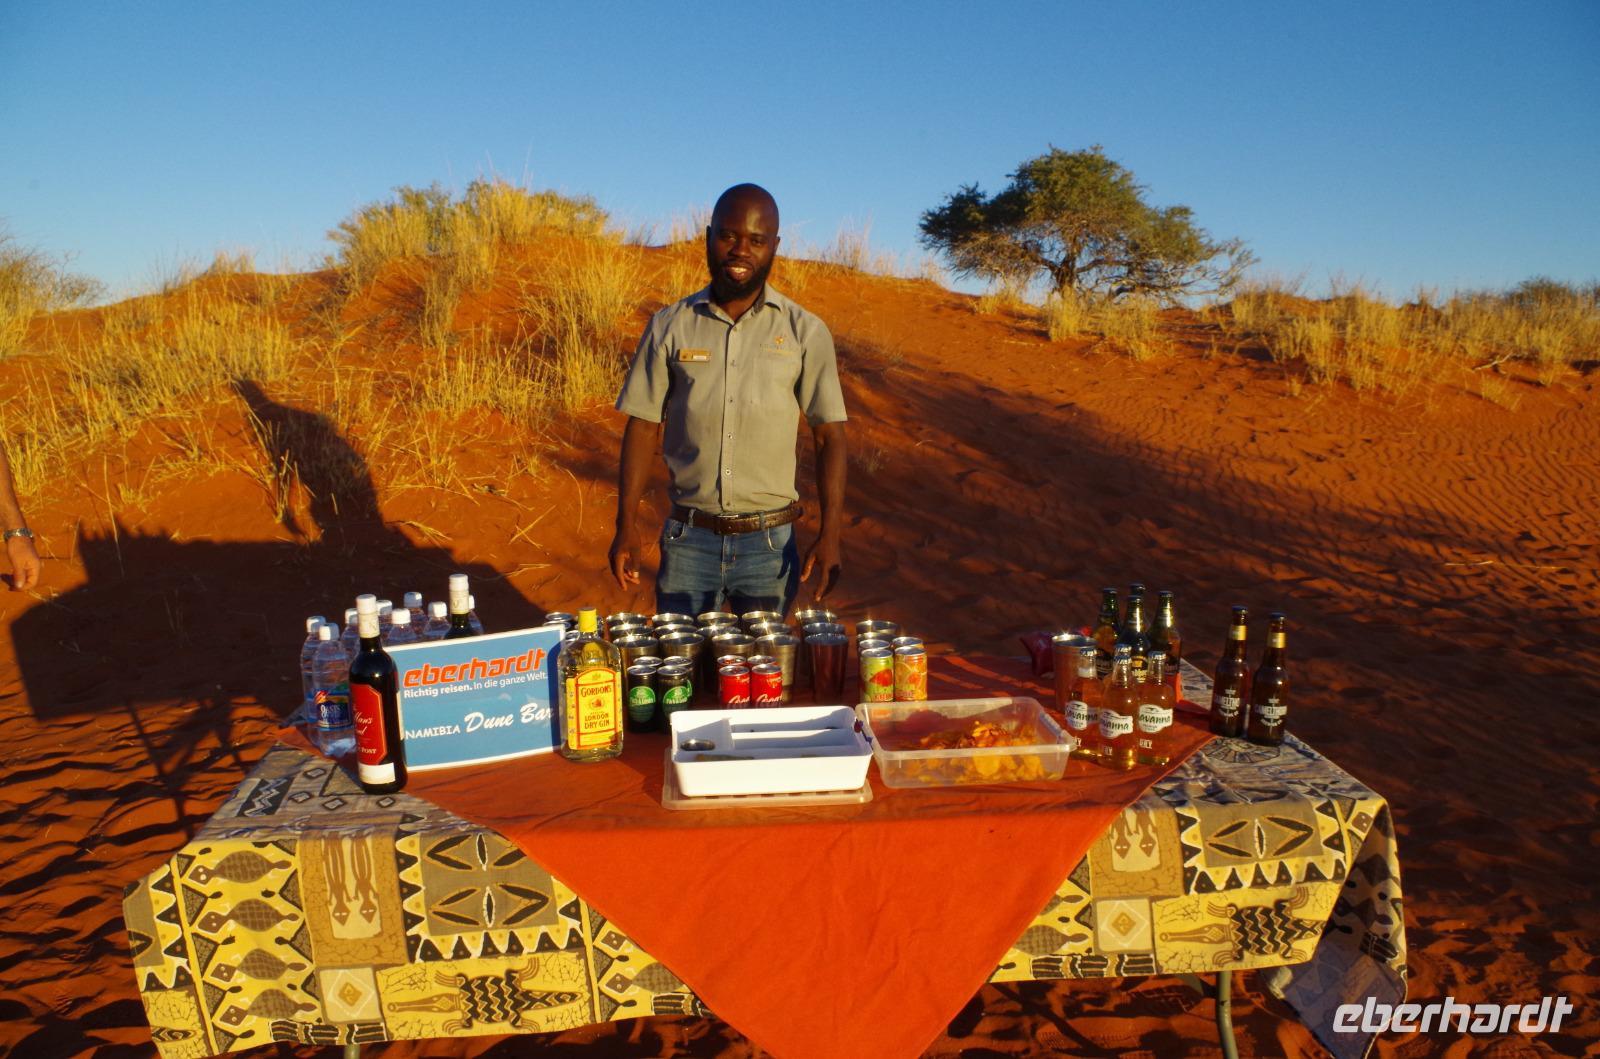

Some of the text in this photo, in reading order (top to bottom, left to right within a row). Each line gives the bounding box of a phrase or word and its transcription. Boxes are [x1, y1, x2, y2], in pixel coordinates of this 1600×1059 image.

[403, 648, 547, 688] eberhardt
[403, 687, 439, 698] Richtig
[441, 684, 472, 694] reisen.
[484, 680, 498, 688] die
[499, 676, 526, 688] ganze
[405, 702, 554, 740] NAMIBIA Dune Bar
[584, 712, 609, 722] LONDON
[584, 719, 610, 730] DRY GIN
